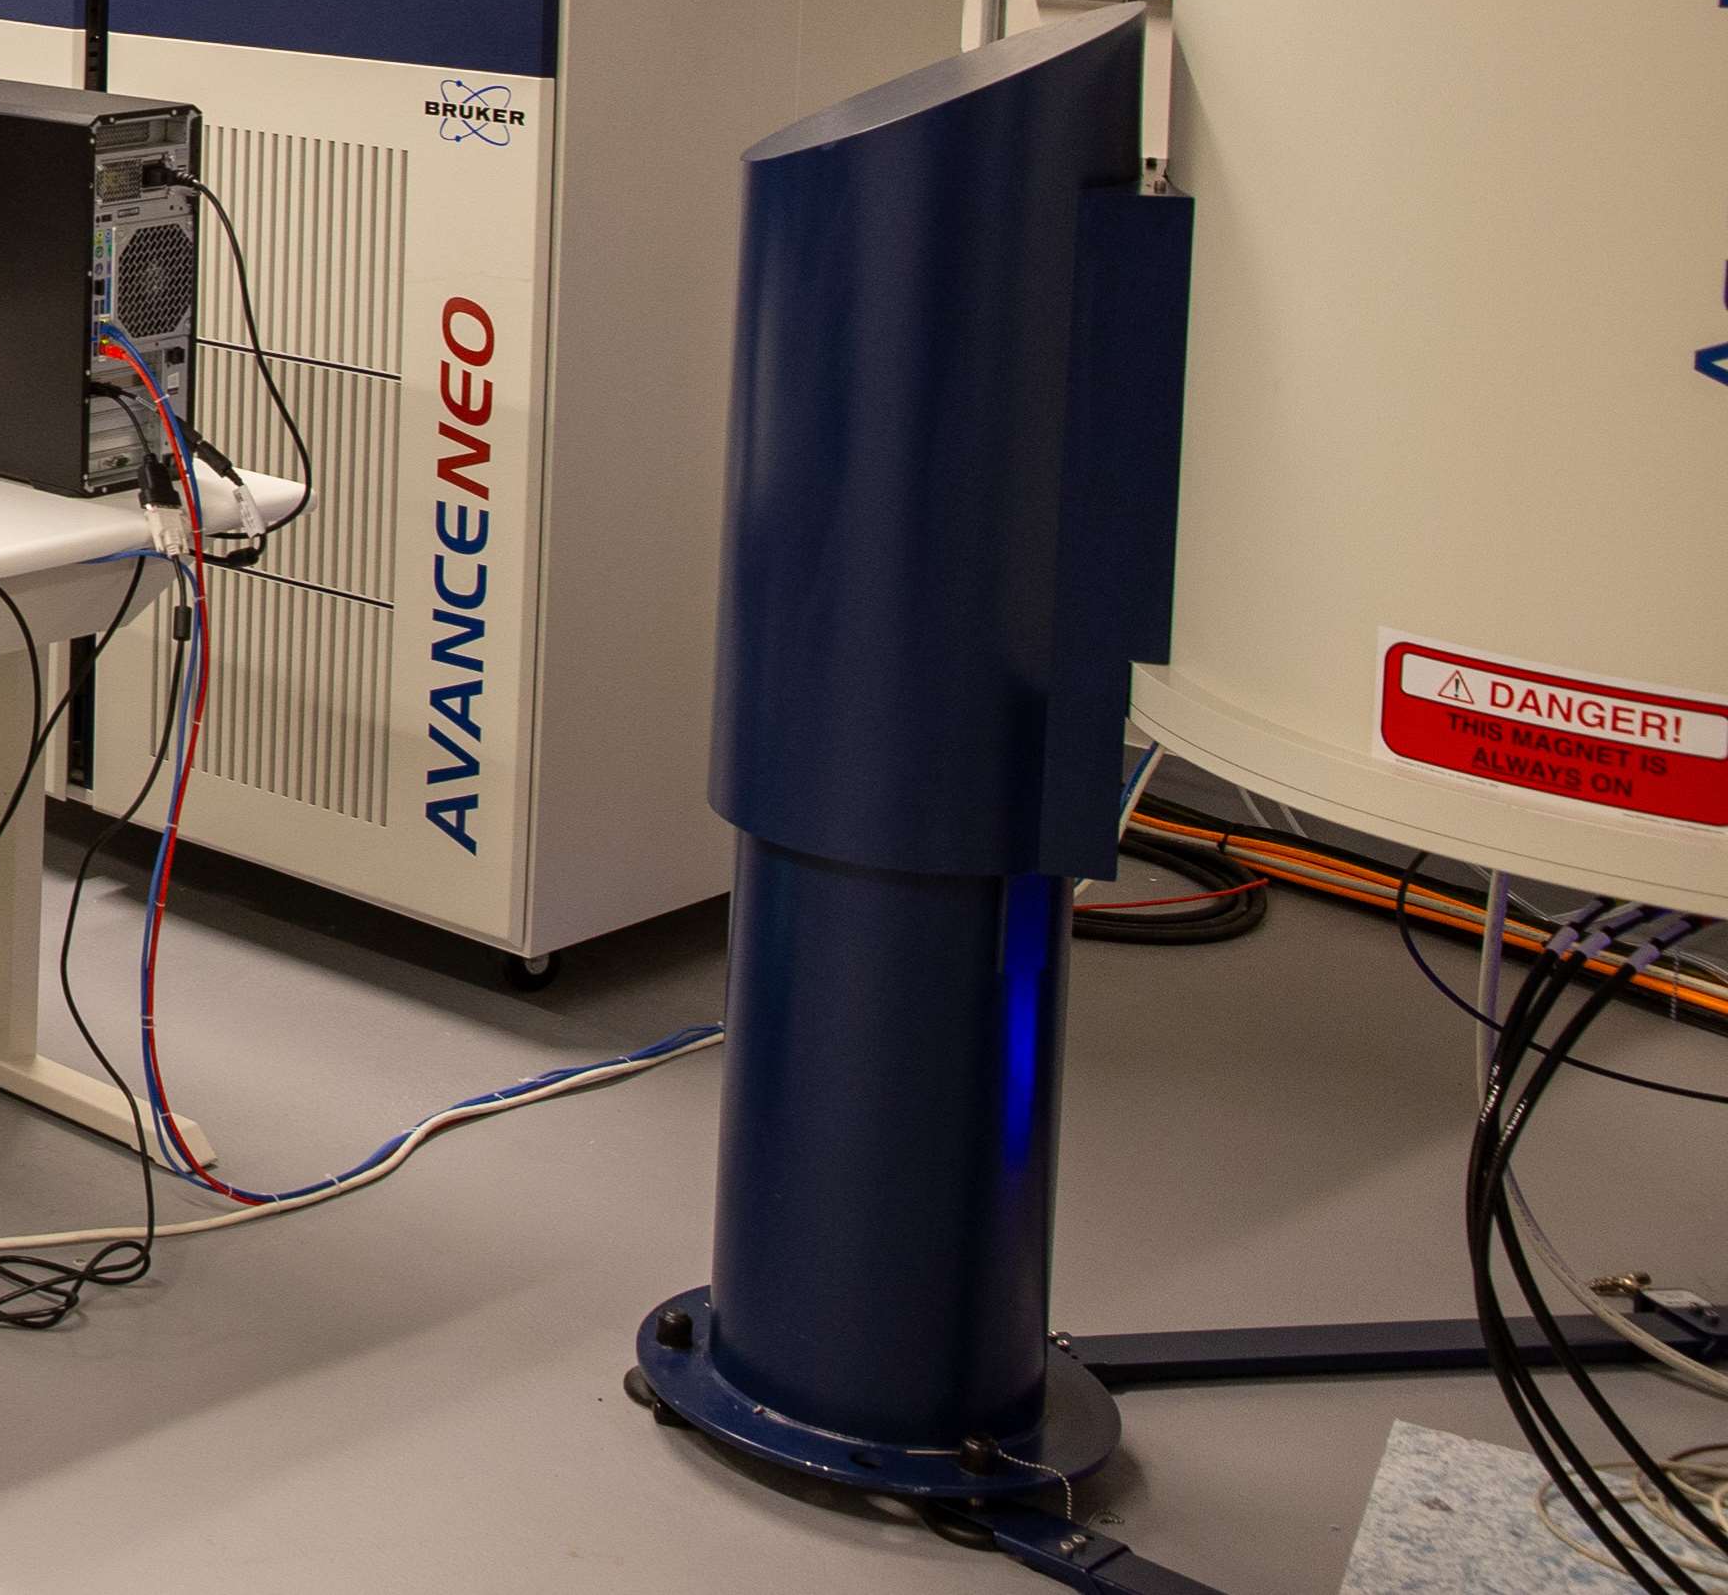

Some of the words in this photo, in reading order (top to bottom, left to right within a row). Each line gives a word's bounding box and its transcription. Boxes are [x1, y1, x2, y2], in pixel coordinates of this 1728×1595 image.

[425, 101, 525, 126] BRUKER
[1489, 681, 1682, 743] DANGER!
[1447, 712, 1503, 742] THIS
[1511, 728, 1630, 768] MAGNET
[1639, 755, 1669, 776] IS
[1471, 746, 1583, 790] ALWAYS
[1589, 773, 1634, 798] ON
